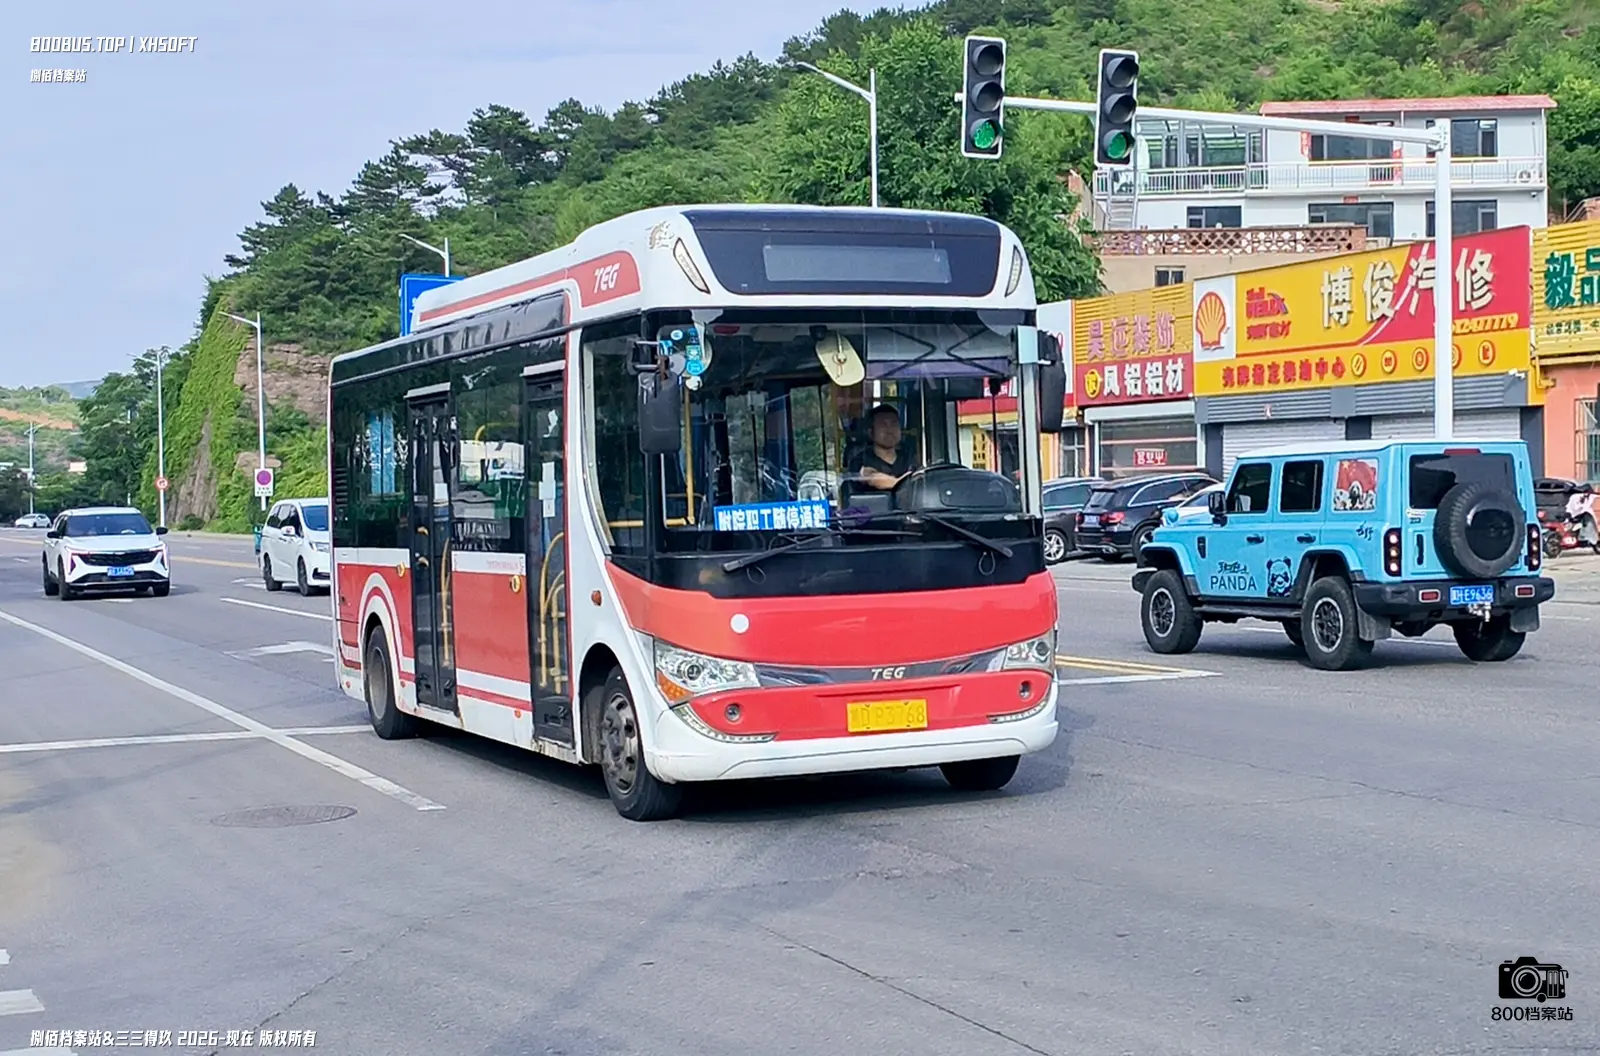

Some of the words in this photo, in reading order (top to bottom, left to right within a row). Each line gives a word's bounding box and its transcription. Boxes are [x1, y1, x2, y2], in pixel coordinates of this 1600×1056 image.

[1321, 247, 1495, 329] 博俊汽修
[1210, 575, 1257, 591] PANDA
[871, 666, 906, 680] TEG
